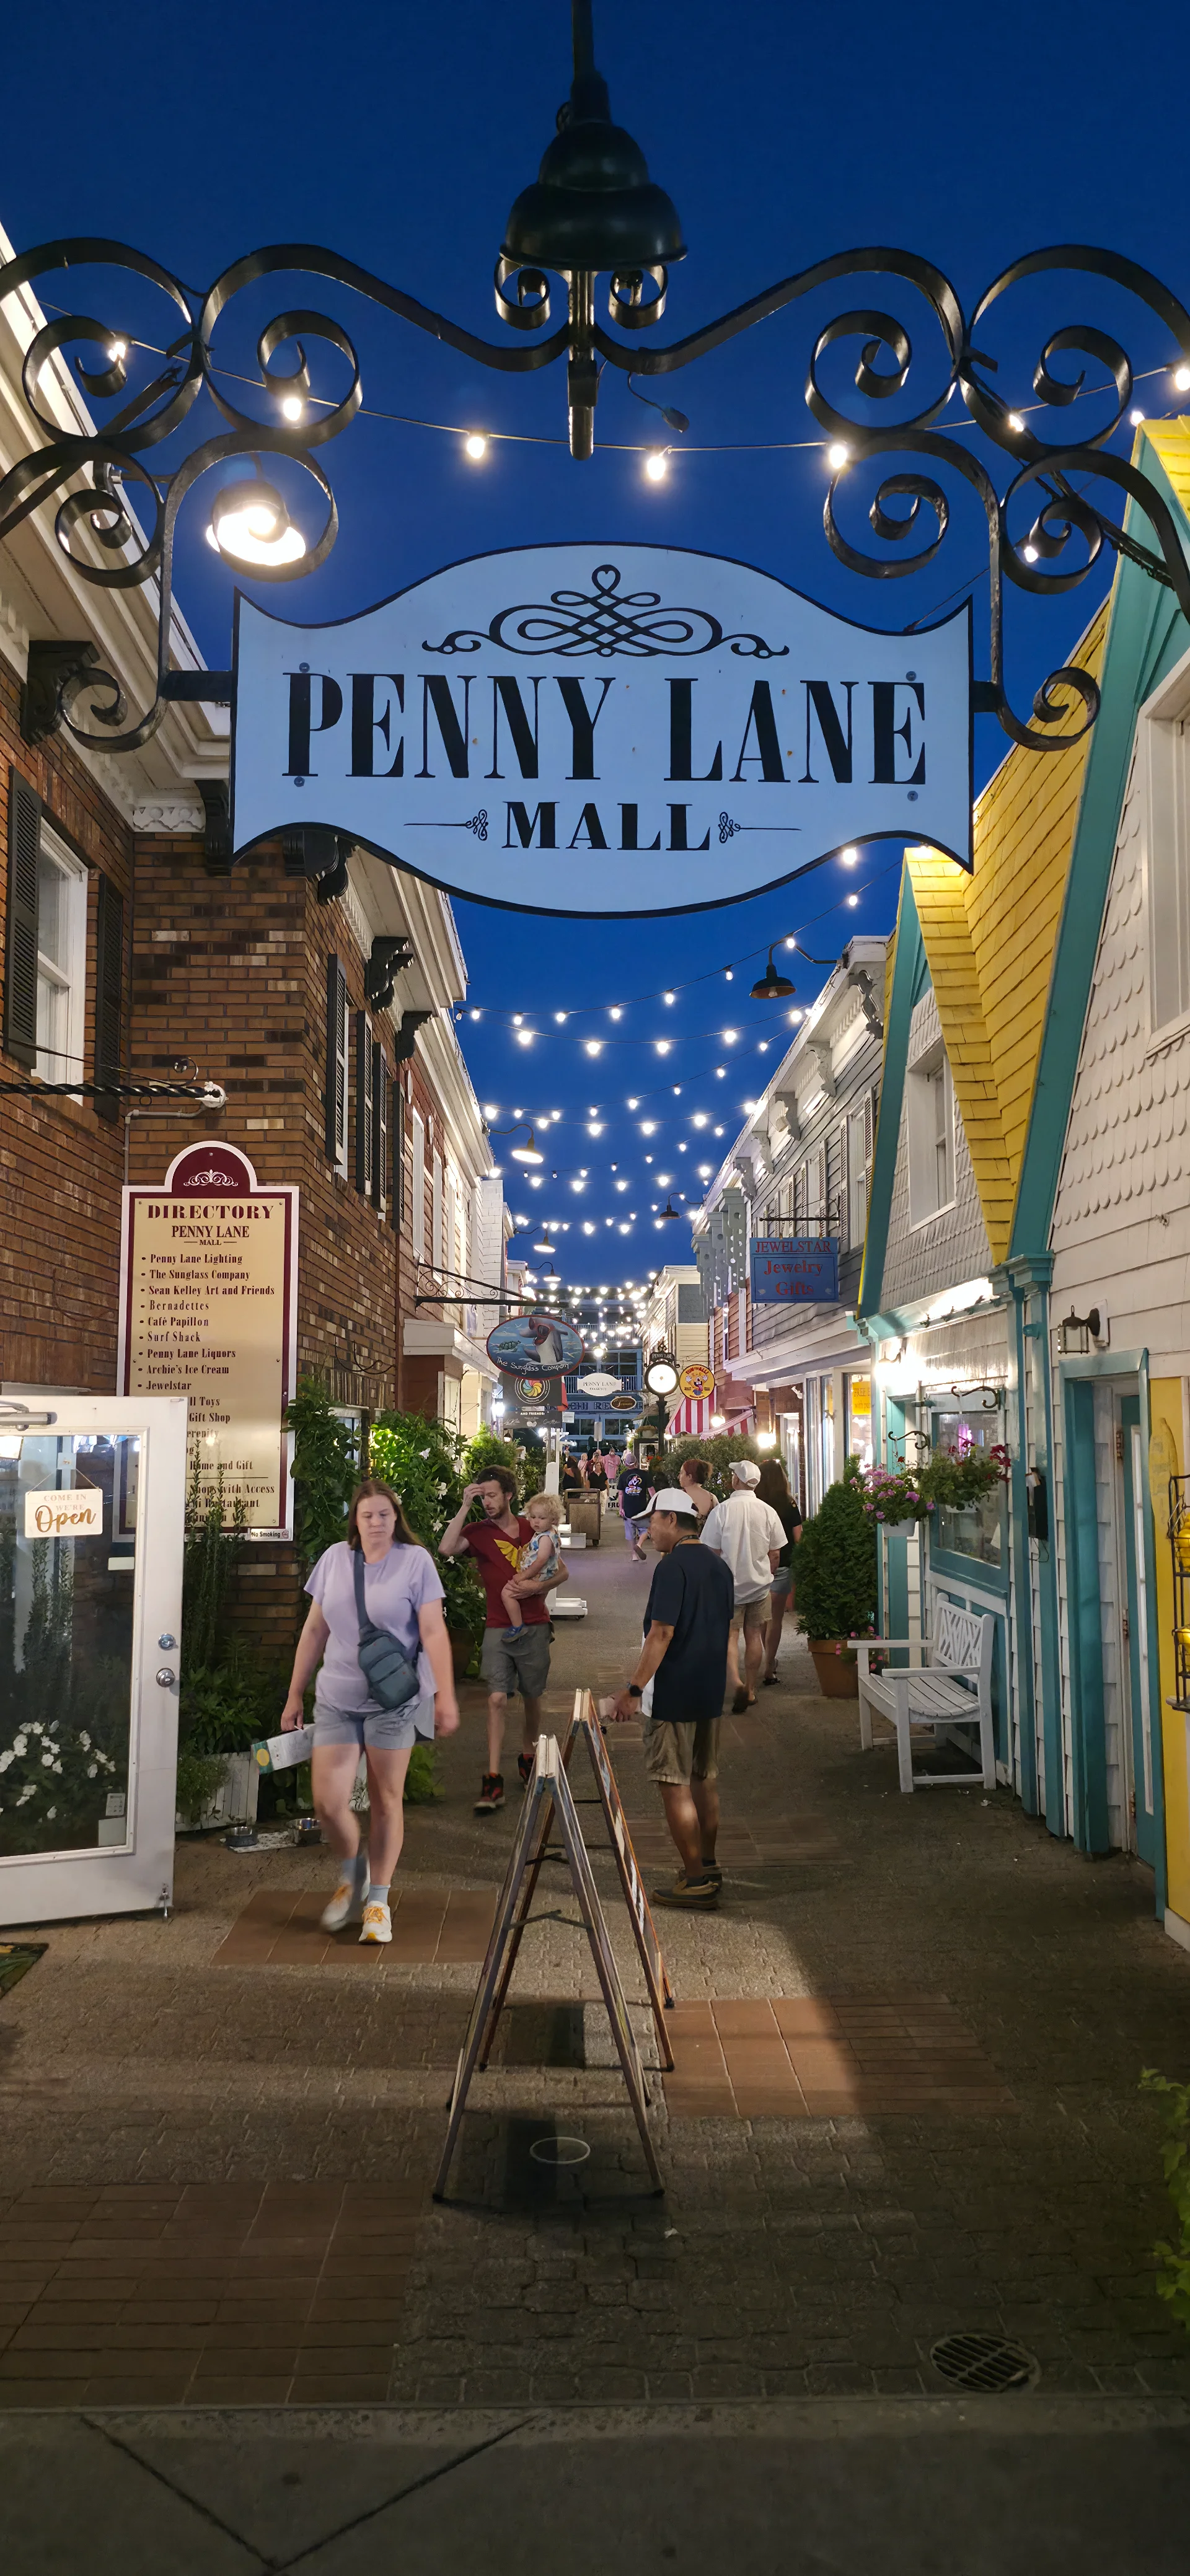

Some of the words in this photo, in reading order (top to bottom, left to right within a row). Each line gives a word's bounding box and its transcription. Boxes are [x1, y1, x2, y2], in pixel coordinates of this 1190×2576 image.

[282, 672, 615, 780] PENNY
[664, 678, 926, 785] LANE
[501, 801, 711, 852] MALL
[147, 1205, 274, 1219] DIRECTORY
[172, 1225, 213, 1238] PENNY
[216, 1226, 250, 1237] LANE
[756, 1241, 832, 1253] JEWELSTAR
[150, 1254, 177, 1265] Penny
[180, 1254, 201, 1264] Lane
[205, 1254, 243, 1265] Lighting
[764, 1260, 823, 1277] Jewelry
[149, 1269, 166, 1280] The
[169, 1269, 209, 1281] Sunglass
[211, 1269, 250, 1281] Company
[149, 1285, 170, 1295] Sean
[174, 1285, 202, 1296] Kelley
[205, 1285, 219, 1295] Art
[222, 1285, 238, 1295] and
[241, 1285, 275, 1295] Friends
[776, 1281, 814, 1295] Gifts
[149, 1300, 209, 1311] Bernadettes
[148, 1316, 167, 1327] Café
[170, 1316, 209, 1328] Papillon
[148, 1331, 170, 1342] Surf
[173, 1331, 201, 1342] Shack
[147, 1348, 174, 1360] Penny
[177, 1348, 199, 1358] Lane
[202, 1348, 236, 1360] Liquors
[146, 1365, 182, 1374] Archie's
[185, 1365, 198, 1374] Ice
[201, 1365, 229, 1374] Cream
[496, 1356, 508, 1366] The
[511, 1363, 539, 1375] Sunglass
[542, 1363, 569, 1371] Company
[146, 1380, 192, 1391] Jewelstar
[200, 1397, 220, 1407] Toys
[189, 1413, 206, 1422] Gift
[209, 1413, 231, 1424] Shop
[187, 1428, 219, 1440] erenity
[236, 1461, 253, 1470] Gift
[245, 1484, 275, 1493] Access
[35, 1505, 97, 1533] Open
[260, 1531, 281, 1539] Smoking
